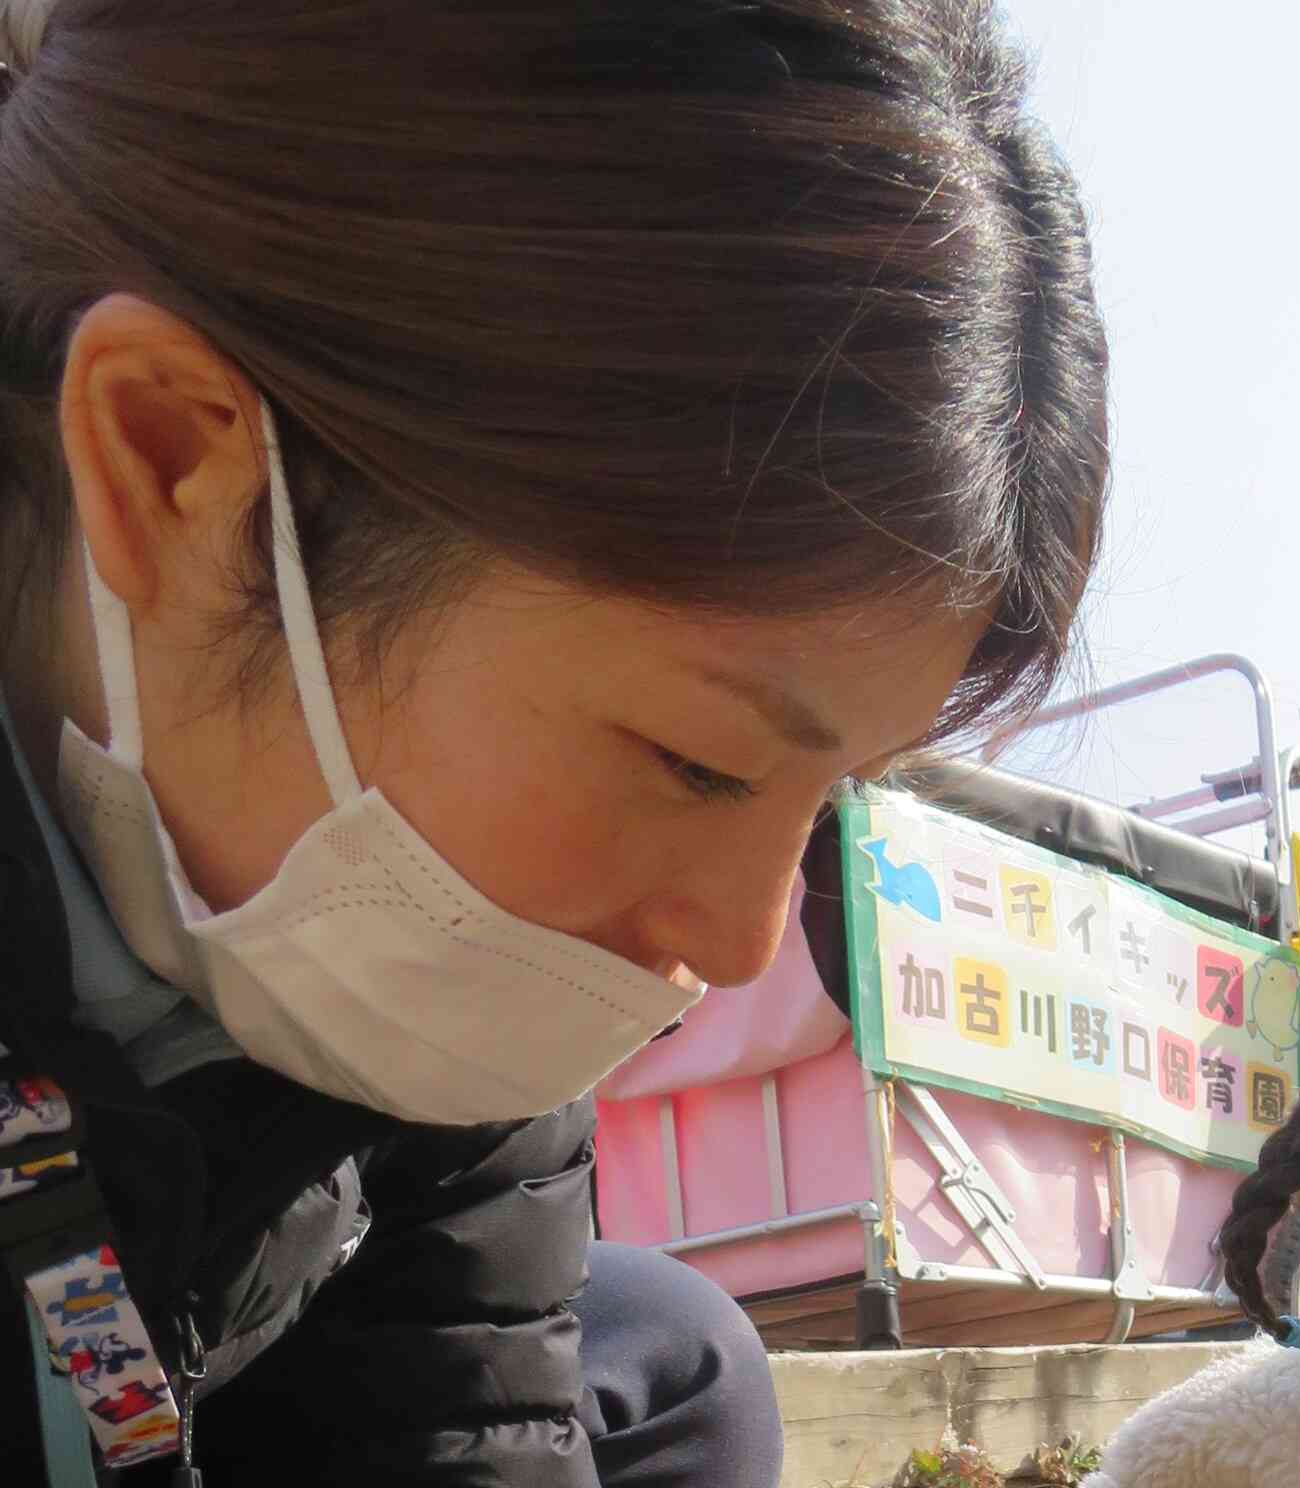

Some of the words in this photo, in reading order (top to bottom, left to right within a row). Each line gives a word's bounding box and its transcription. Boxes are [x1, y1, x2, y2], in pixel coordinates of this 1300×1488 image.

[952, 868, 1240, 1018] ニチイキッズ
[898, 952, 1286, 1126] 加古川野口保育園
